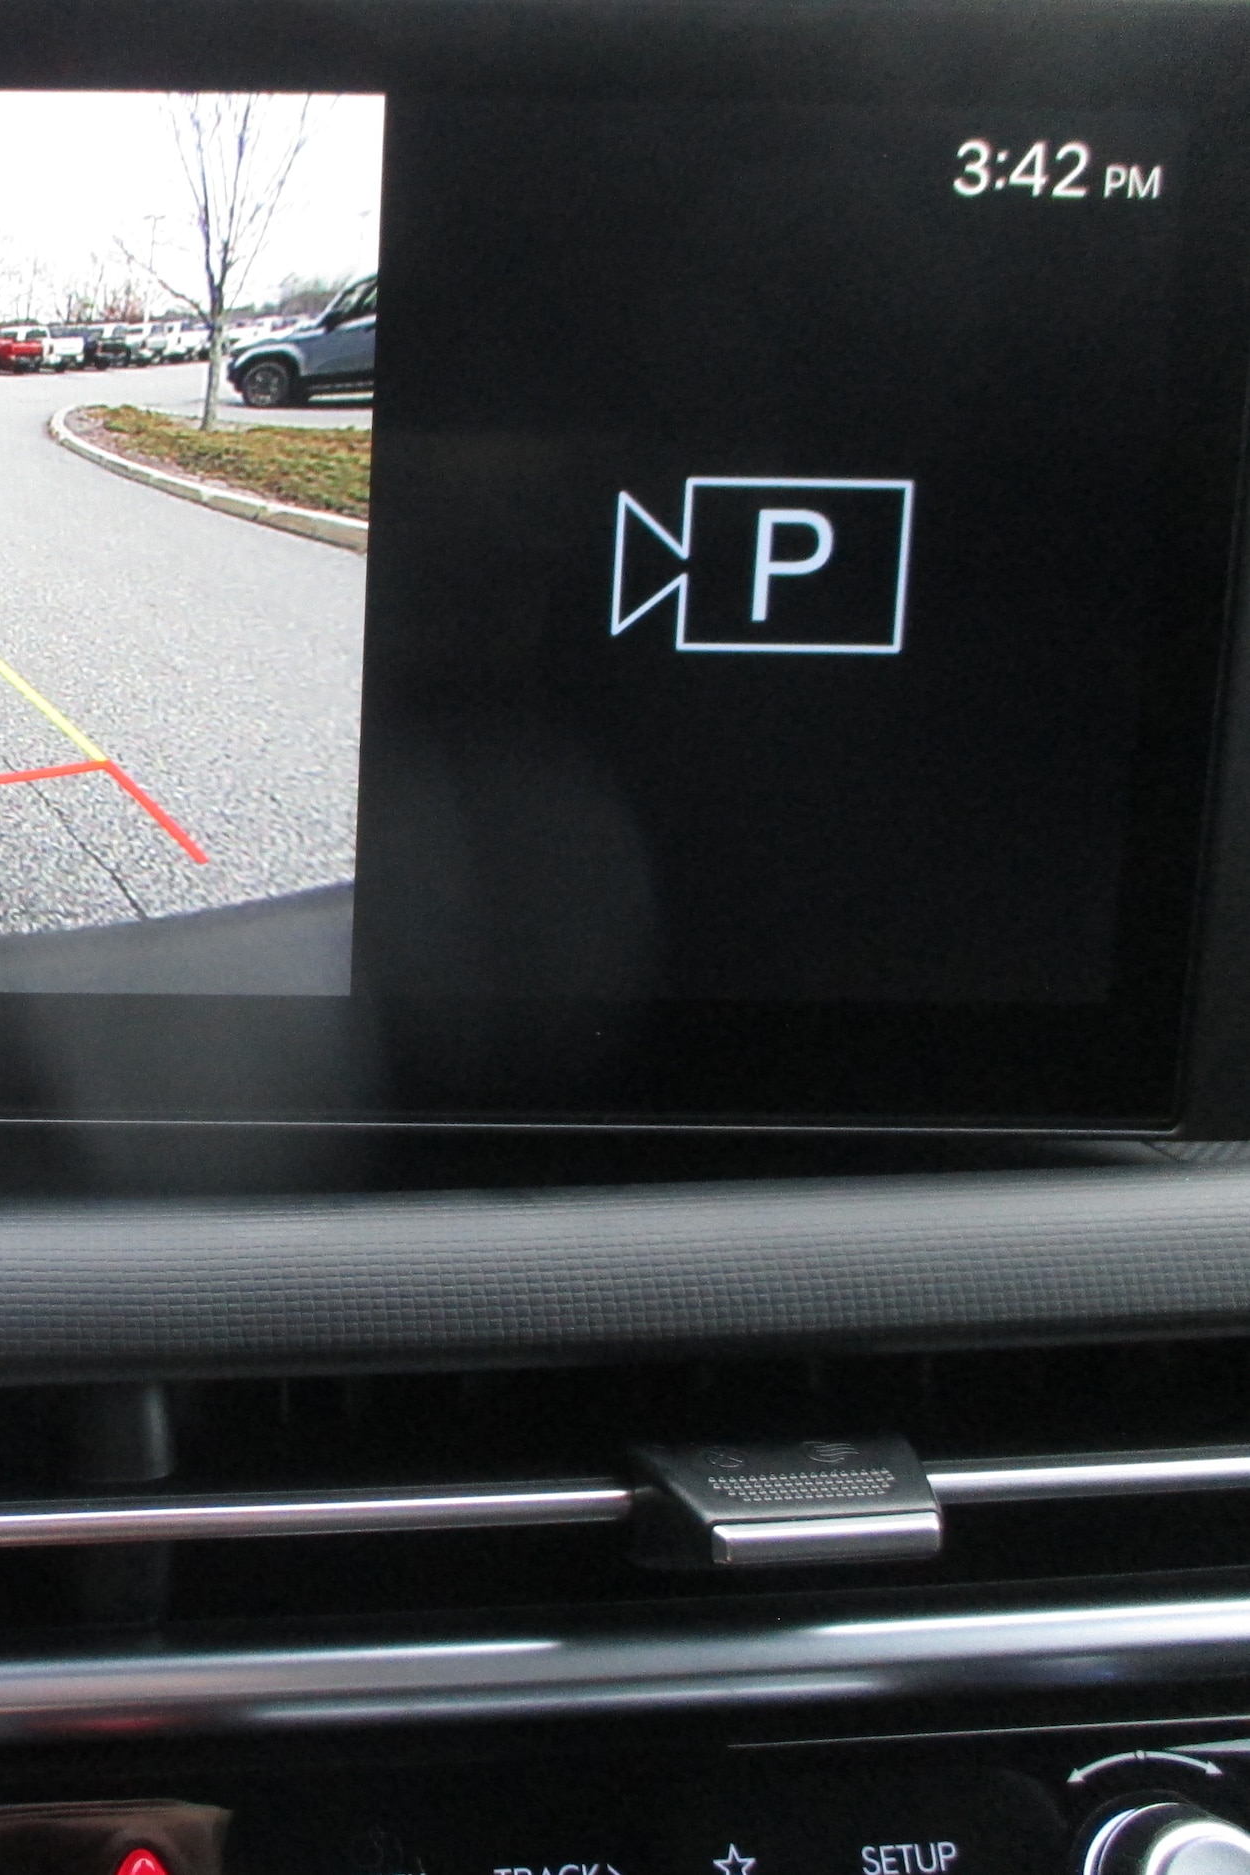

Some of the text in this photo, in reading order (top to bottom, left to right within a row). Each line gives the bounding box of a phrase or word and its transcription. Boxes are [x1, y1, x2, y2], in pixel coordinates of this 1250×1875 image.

[953, 138, 1163, 199] 3:42 PM
[752, 509, 833, 622] P
[861, 1841, 957, 1875] SETUP
